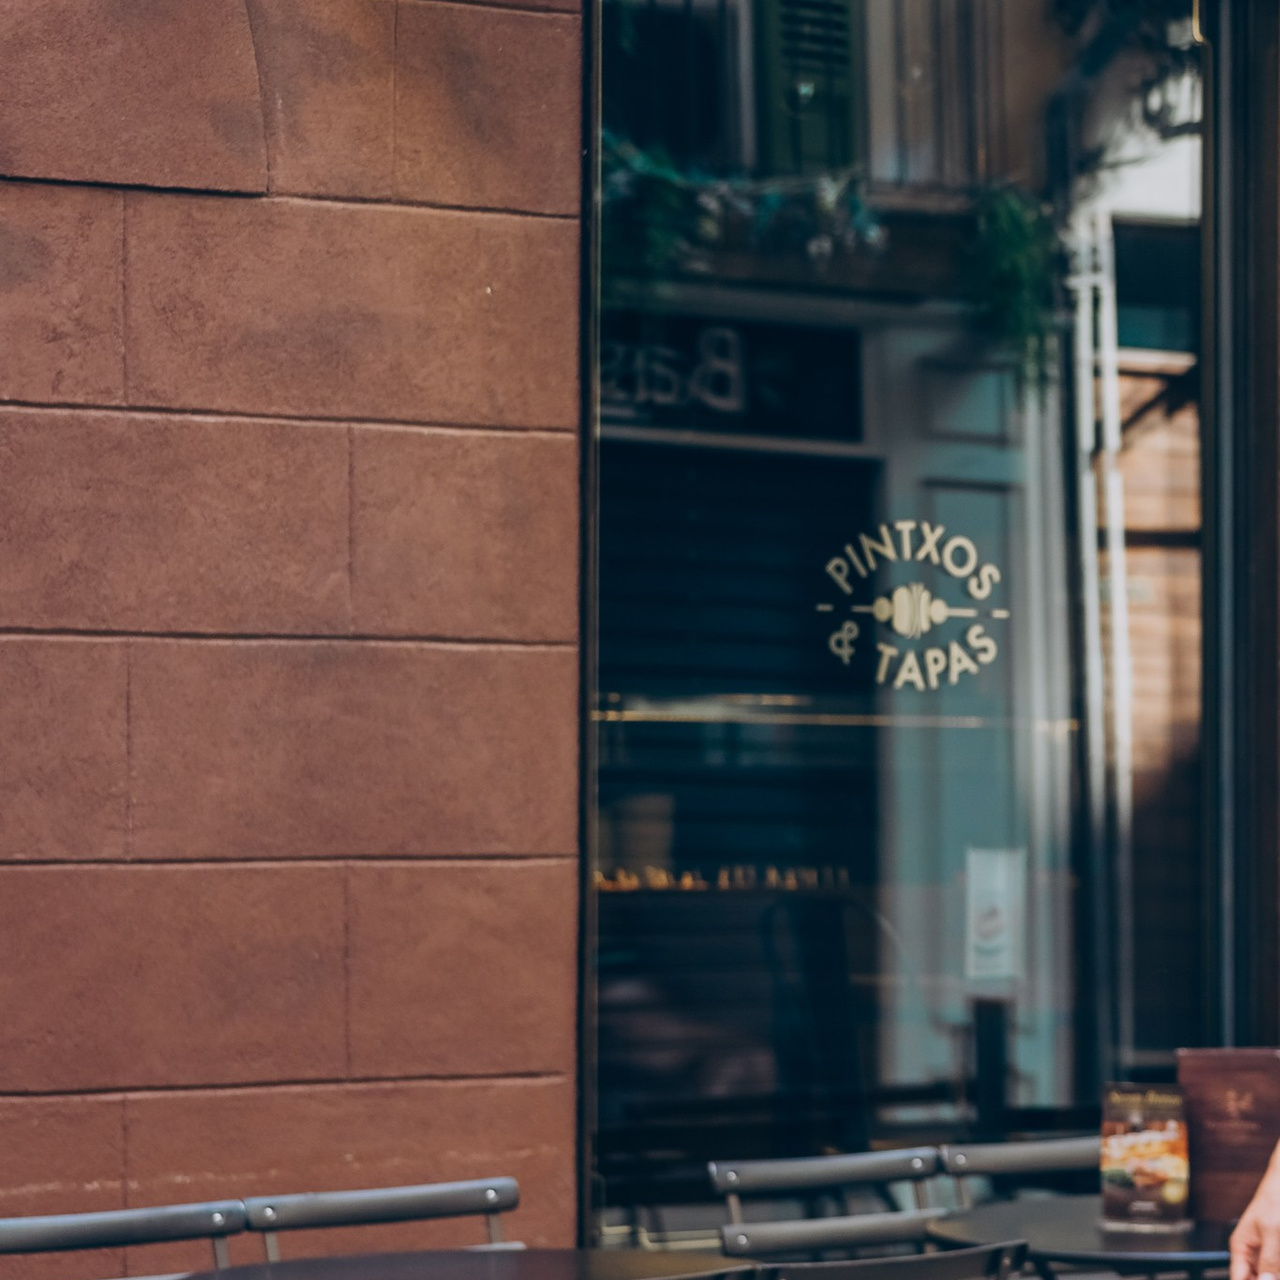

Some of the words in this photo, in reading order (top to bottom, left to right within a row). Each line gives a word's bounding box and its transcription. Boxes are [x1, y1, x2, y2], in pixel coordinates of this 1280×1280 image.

[825, 520, 1001, 600] PINTXOS
[829, 620, 859, 665] &
[876, 624, 998, 691] TAPAS
